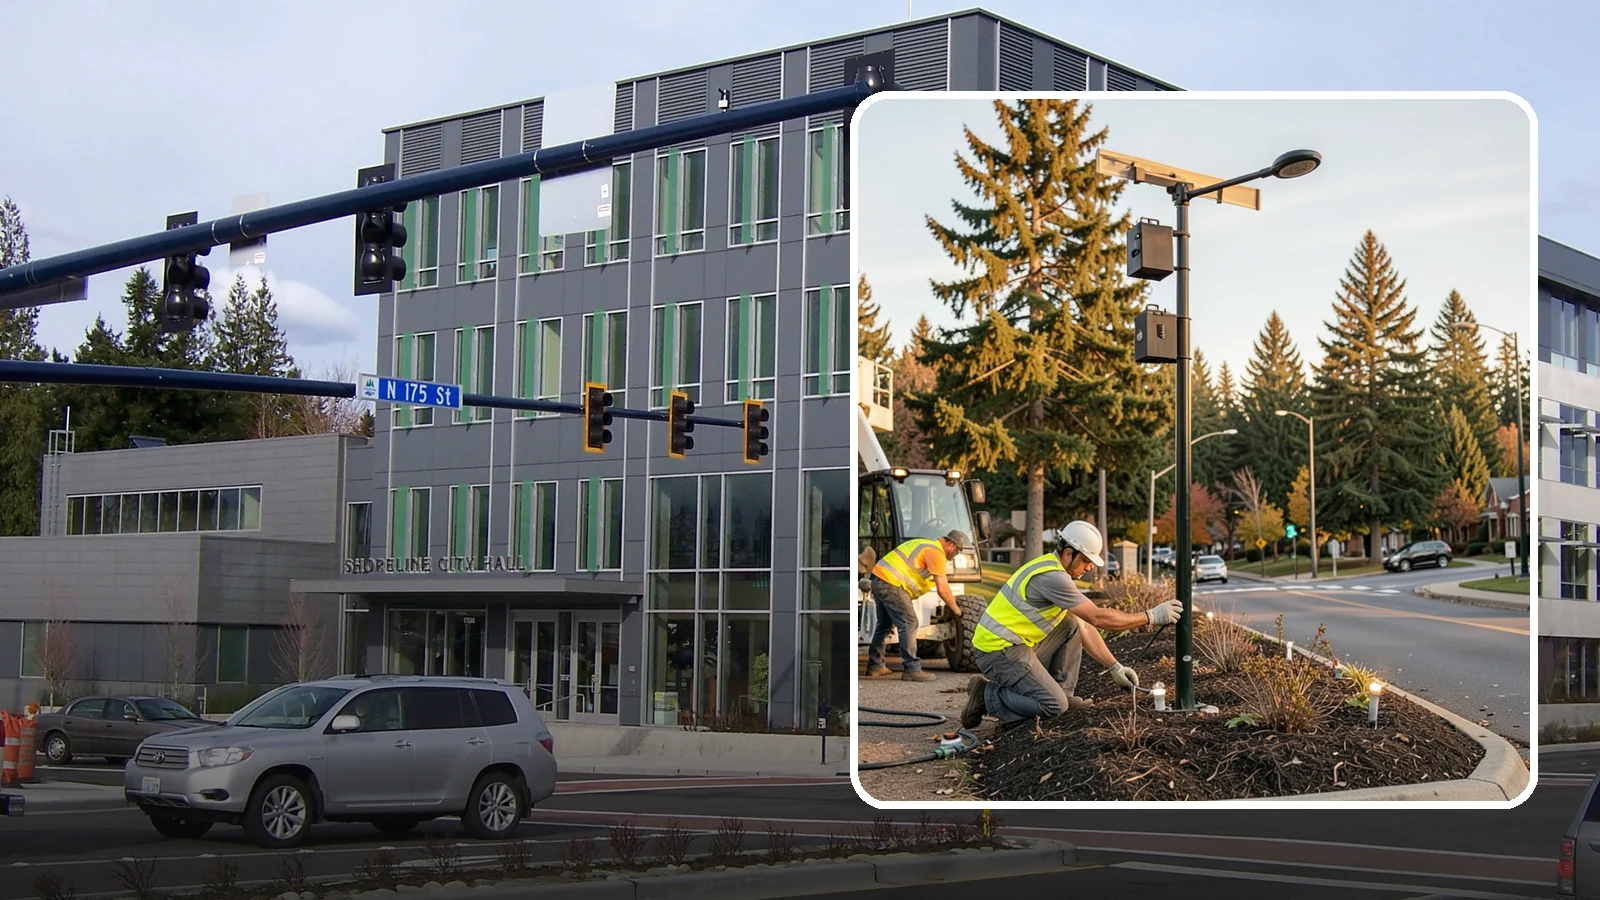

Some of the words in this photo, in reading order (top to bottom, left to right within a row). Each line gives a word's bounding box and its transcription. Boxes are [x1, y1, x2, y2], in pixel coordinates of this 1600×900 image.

[387, 380, 396, 400] N
[405, 382, 428, 403] 175
[436, 386, 451, 406] St
[343, 557, 432, 574] SHORELINE
[438, 556, 476, 572] CITY
[484, 555, 525, 571] HALL
